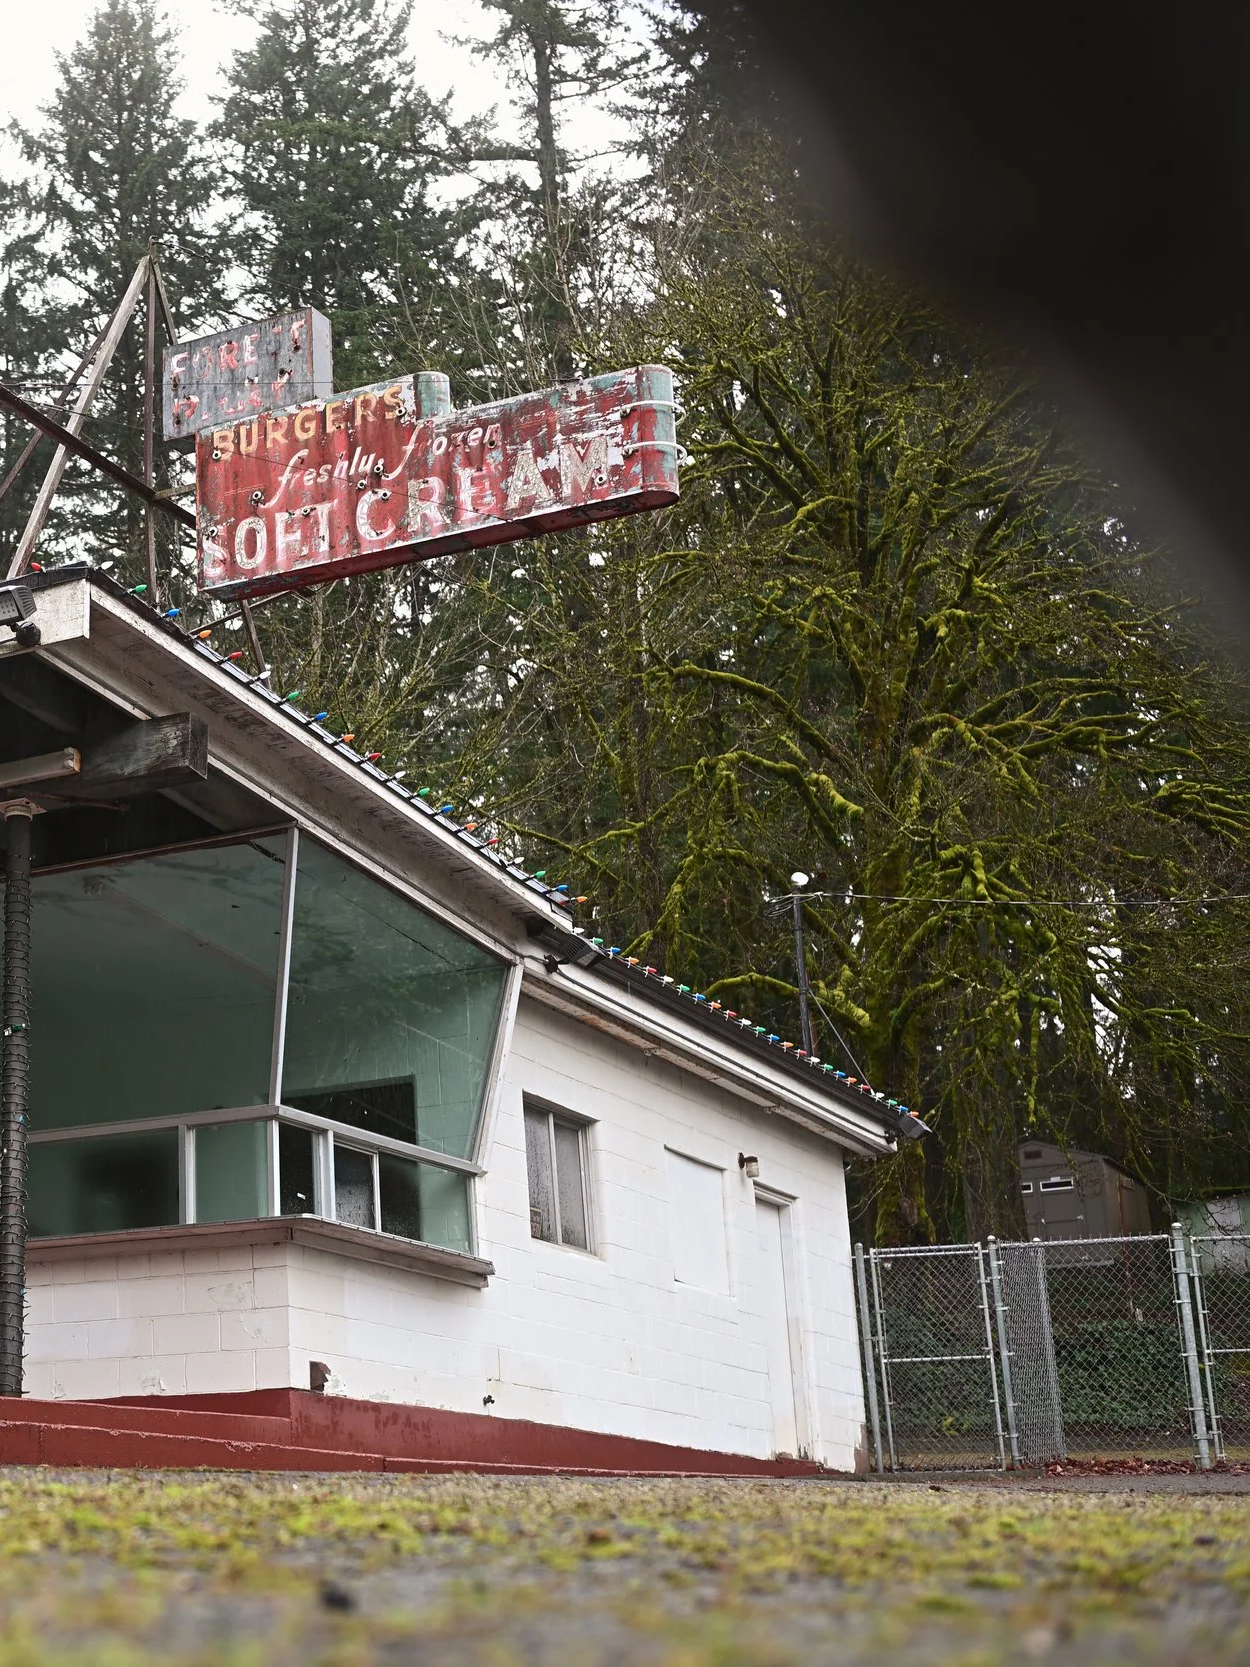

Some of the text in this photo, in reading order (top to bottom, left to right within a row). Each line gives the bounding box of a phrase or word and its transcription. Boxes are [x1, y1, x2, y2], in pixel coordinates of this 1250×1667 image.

[170, 318, 306, 389] FORET
[213, 384, 404, 461] BURGERS
[202, 437, 609, 578] SOFT CREAM
